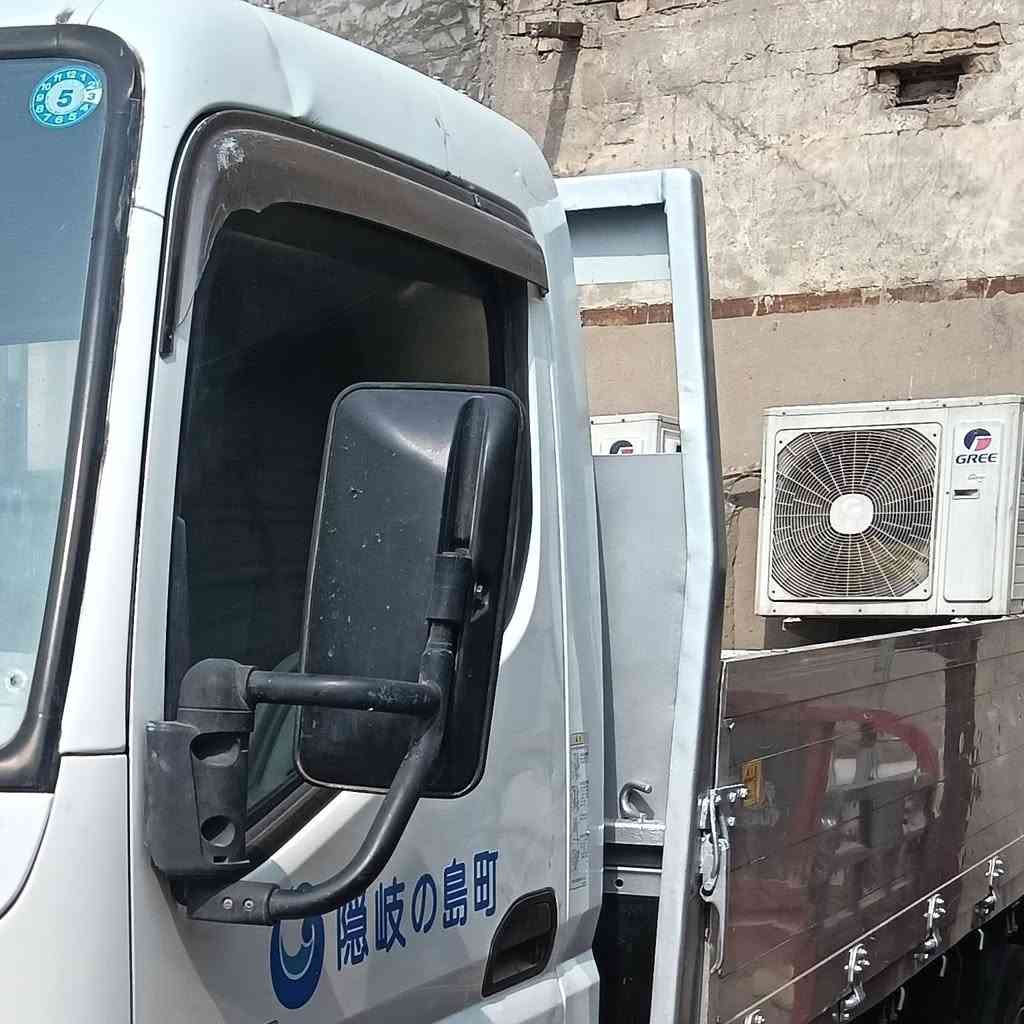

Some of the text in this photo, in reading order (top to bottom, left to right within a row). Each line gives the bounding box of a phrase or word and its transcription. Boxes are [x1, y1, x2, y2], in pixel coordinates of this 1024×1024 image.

[56, 89, 74, 108] 5
[955, 452, 998, 465] GREE
[337, 848, 500, 972] 隠岐の島町
